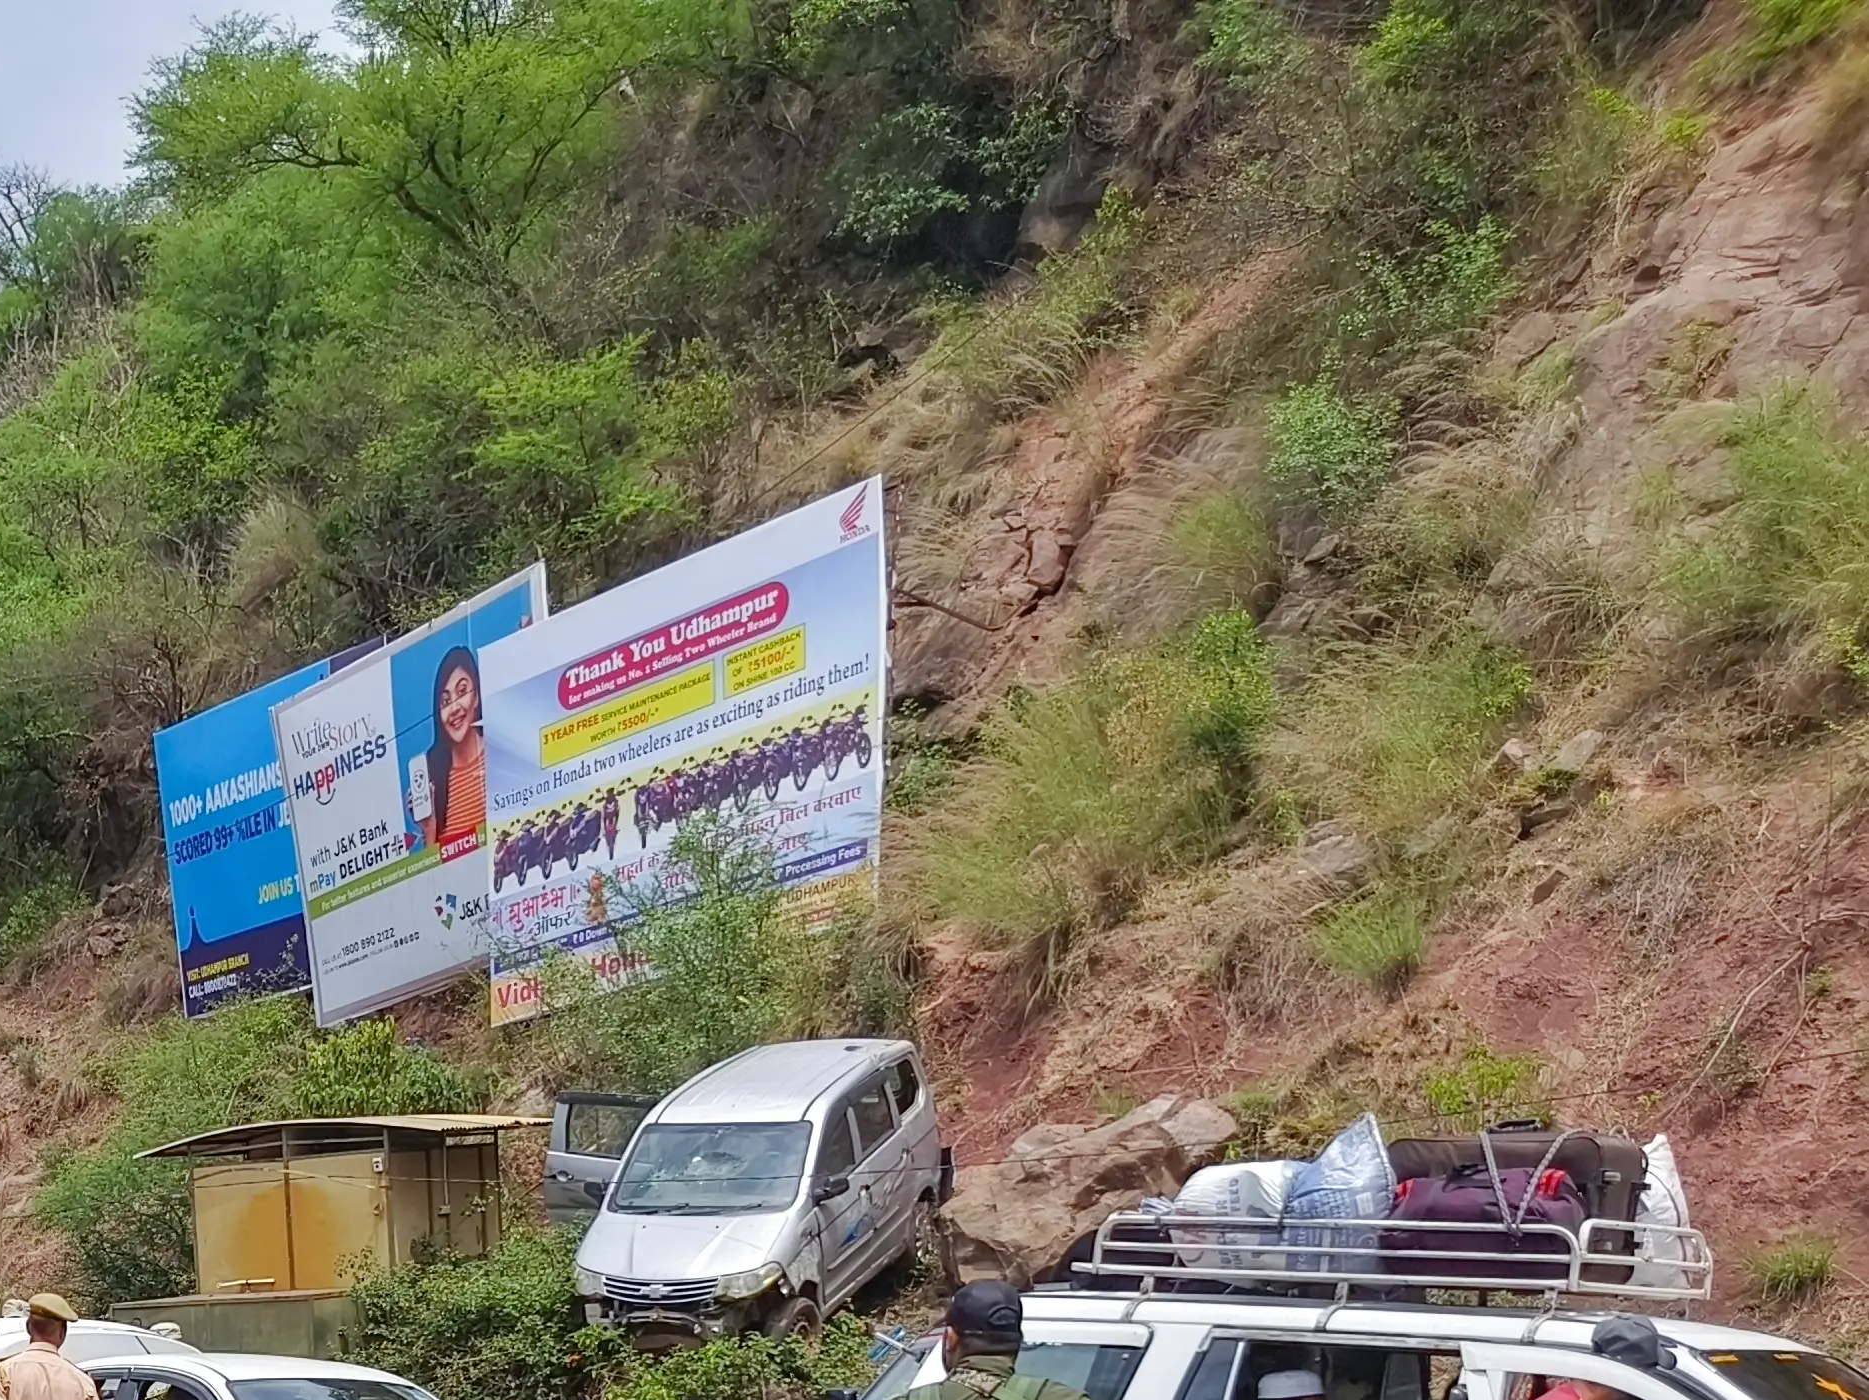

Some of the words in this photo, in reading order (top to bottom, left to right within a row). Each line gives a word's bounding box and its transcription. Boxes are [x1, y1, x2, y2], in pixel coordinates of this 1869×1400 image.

[839, 525, 871, 544] HONDA
[565, 650, 626, 689] Thank
[628, 634, 666, 663] You
[669, 589, 780, 646] Udhampur
[726, 646, 757, 665] INSTANT
[759, 631, 802, 655] CASHBACK
[568, 692, 582, 705] for
[583, 680, 616, 699] making
[617, 676, 627, 686] us
[628, 667, 643, 681] No.
[652, 652, 684, 673] Selling
[684, 643, 706, 659] Two
[707, 628, 746, 648] Wheeler
[747, 612, 777, 633] Brand
[733, 666, 743, 677] OF
[733, 679, 746, 691] ON
[746, 670, 769, 687] SHINE
[770, 666, 783, 678] 100
[784, 660, 796, 672] CC
[543, 733, 550, 746] 3
[550, 722, 576, 742] YEAR
[576, 714, 600, 732] FREE
[601, 705, 628, 722] SERVICE
[629, 685, 678, 711] MAINTENANCE
[678, 672, 711, 692] PACKAGE
[494, 785, 534, 811] Savings
[536, 780, 550, 795] on
[553, 763, 591, 789] Honda
[594, 755, 616, 773] two
[618, 734, 672, 762] wheelers
[674, 725, 694, 744] are
[696, 718, 710, 735] as
[712, 699, 764, 728] exciting
[766, 692, 781, 709] as
[783, 675, 825, 703] riding
[828, 653, 870, 685] them!
[590, 728, 616, 742] WORTH
[302, 747, 317, 759] YOUR
[318, 741, 330, 752] OWN
[169, 794, 203, 828] 1000+
[205, 761, 283, 815] AAKASHIANS
[174, 831, 213, 865] SCORED
[214, 825, 234, 851] 99+
[235, 812, 262, 842] %ILE
[263, 804, 276, 833] IN
[278, 801, 292, 829] JE
[310, 846, 331, 868] with
[334, 833, 357, 857] J&K
[359, 819, 389, 845] Bank
[310, 871, 336, 894] mPay
[339, 843, 391, 880] DELIGHT
[371, 878, 382, 889] and
[441, 834, 477, 859] SWITCH
[785, 852, 837, 877] Processing
[258, 882, 280, 904] JOIN
[280, 877, 294, 897] US
[459, 899, 483, 921] J&K
[342, 942, 359, 956] 1800
[360, 935, 376, 950] 890
[376, 927, 395, 943] 2122
